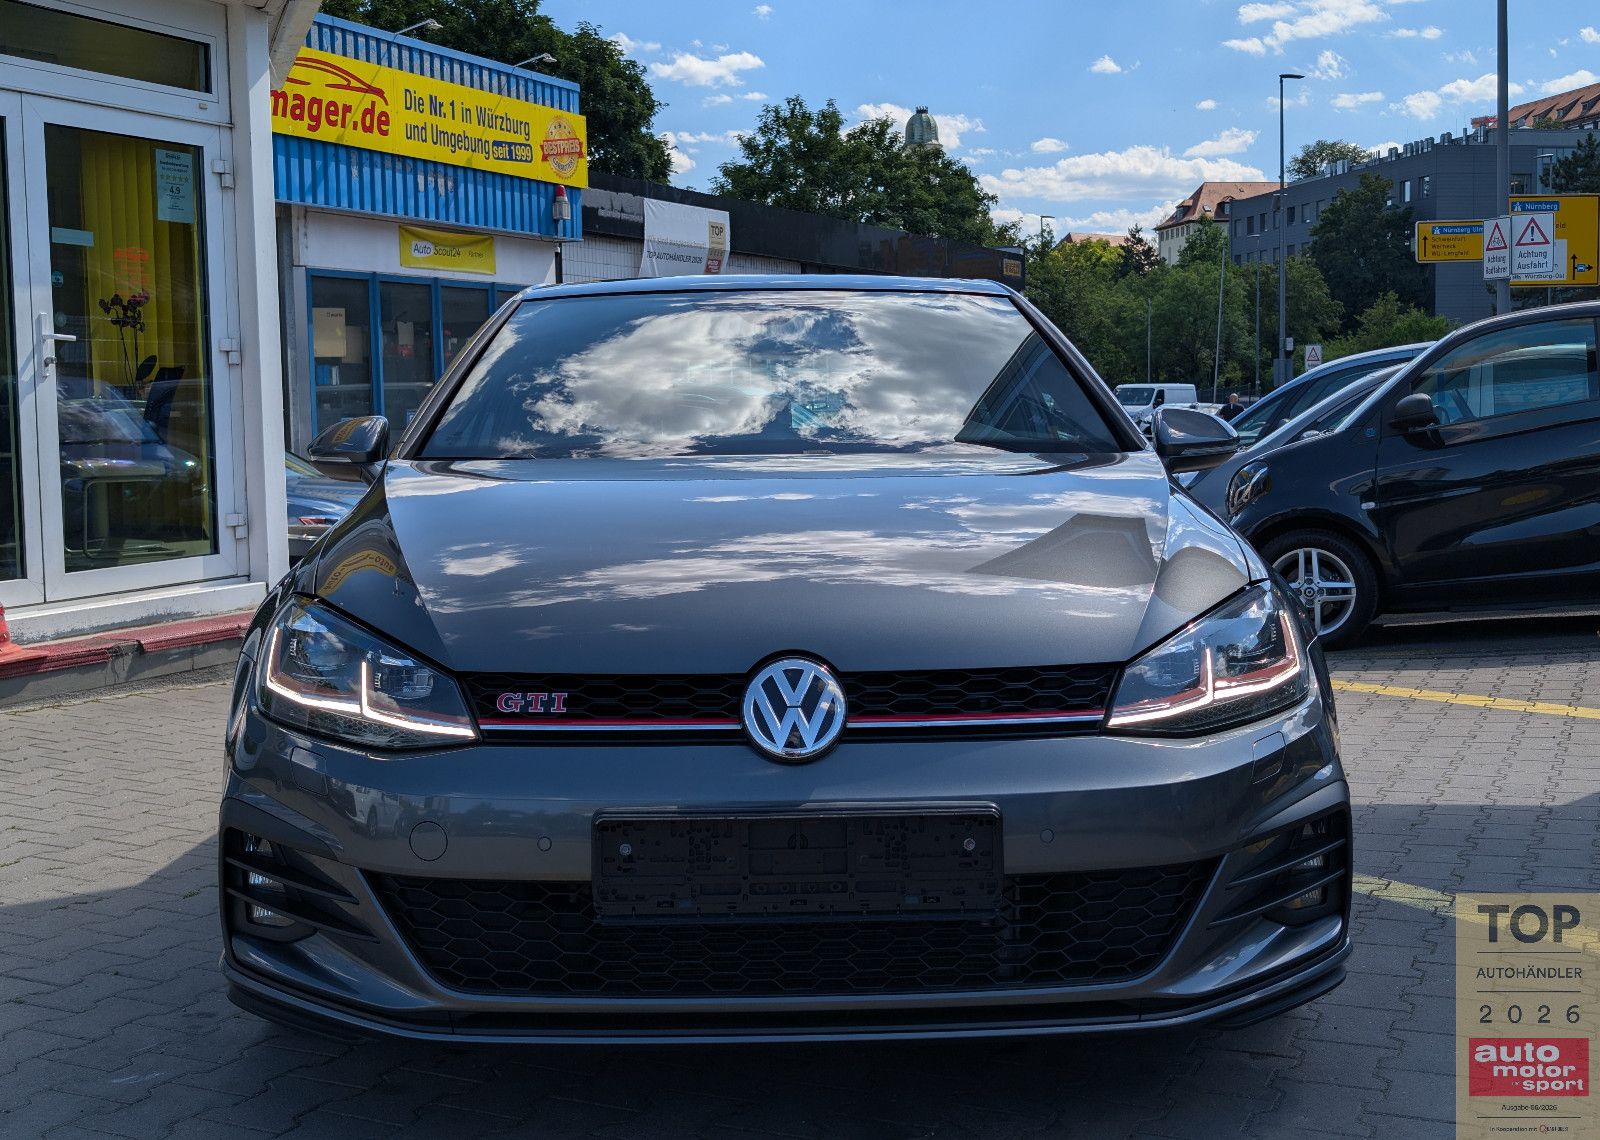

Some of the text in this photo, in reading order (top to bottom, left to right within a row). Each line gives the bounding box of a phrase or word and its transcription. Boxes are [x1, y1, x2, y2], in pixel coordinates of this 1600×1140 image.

[404, 88, 531, 141] Die Nr. 1 in Würzburg
[405, 122, 532, 162] und Umgebung seit 1999
[543, 138, 580, 155] BESTPREIS
[1525, 202, 1558, 211] Nürnberg
[710, 224, 724, 236] TOP
[646, 250, 656, 258] TOP
[1487, 255, 1507, 264] Achtung
[1518, 250, 1547, 260] Achtung
[1516, 261, 1548, 270] Ausfahrt
[496, 692, 568, 713] GTI
[747, 661, 841, 754] VW
